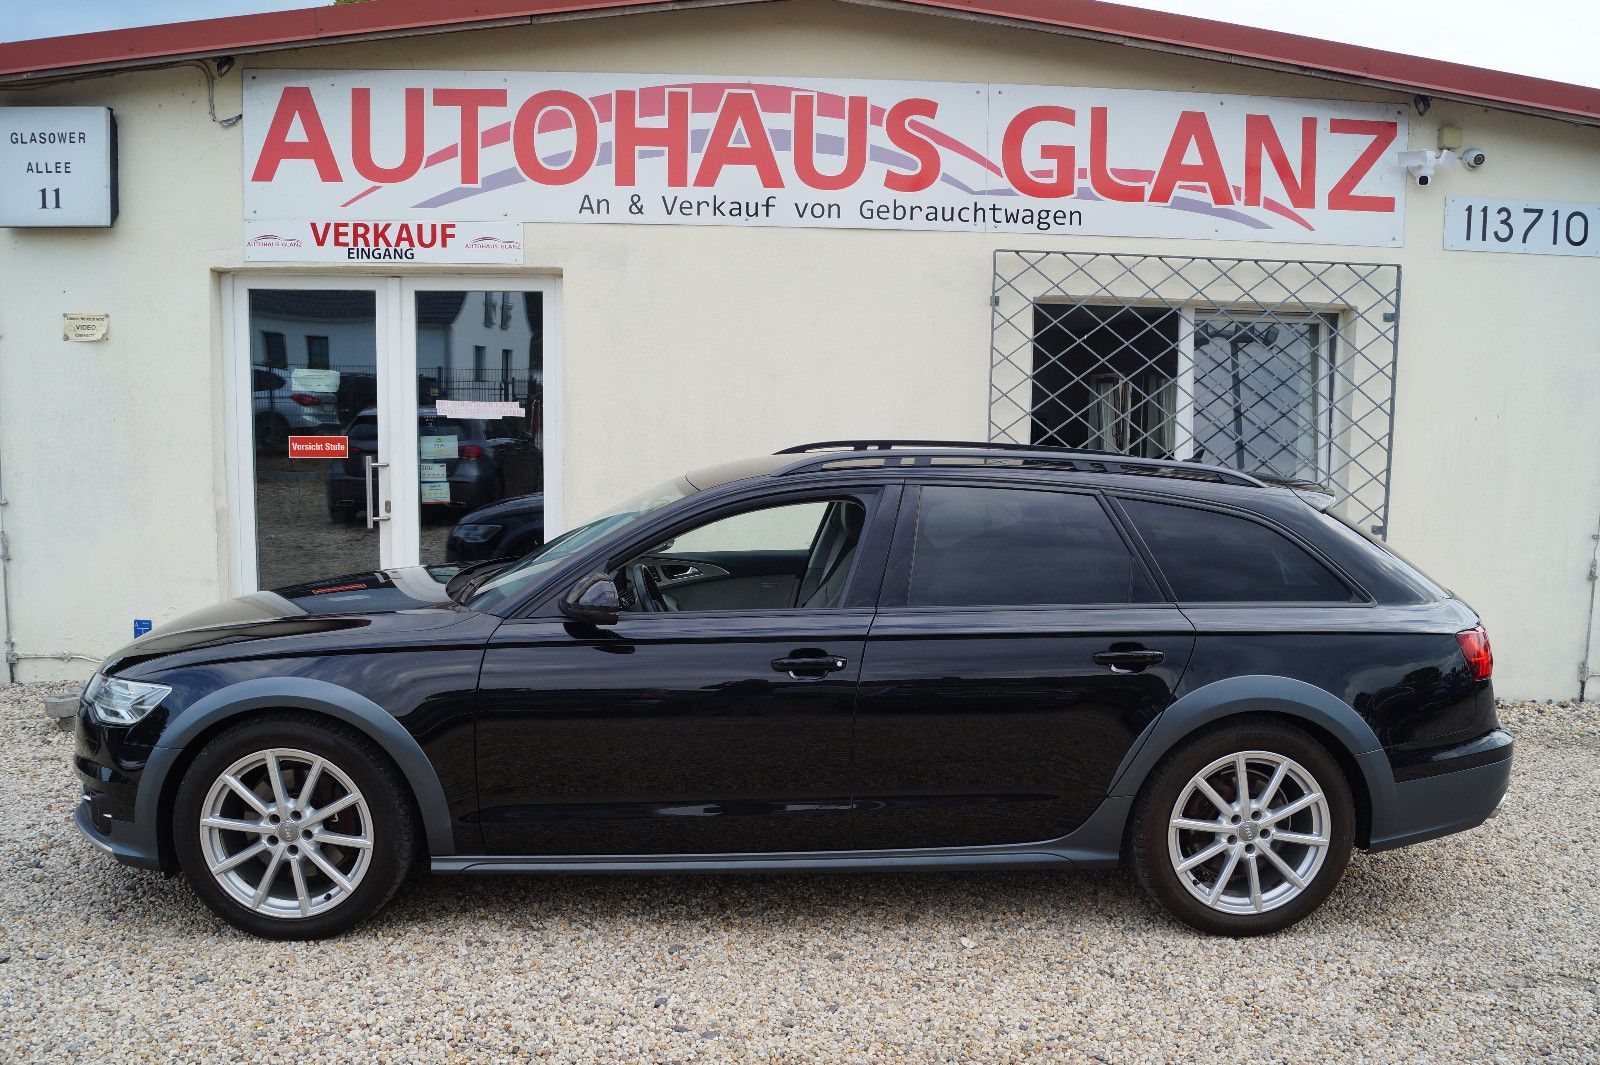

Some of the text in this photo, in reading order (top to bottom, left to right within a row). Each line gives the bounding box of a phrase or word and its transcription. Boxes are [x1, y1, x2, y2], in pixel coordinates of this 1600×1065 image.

[10, 131, 86, 144] GLASOWER
[251, 86, 1398, 213] AUTOHAUS GLANZ
[26, 161, 72, 174] ALLEE
[38, 187, 63, 209] 11
[578, 193, 1083, 230] An & Verkauf von Gebrauchtwagen
[309, 222, 456, 249] VERKAUF
[1464, 204, 1589, 247] 113710
[347, 247, 415, 260] EINGANG
[292, 442, 345, 451] Vorsicht Stufe
